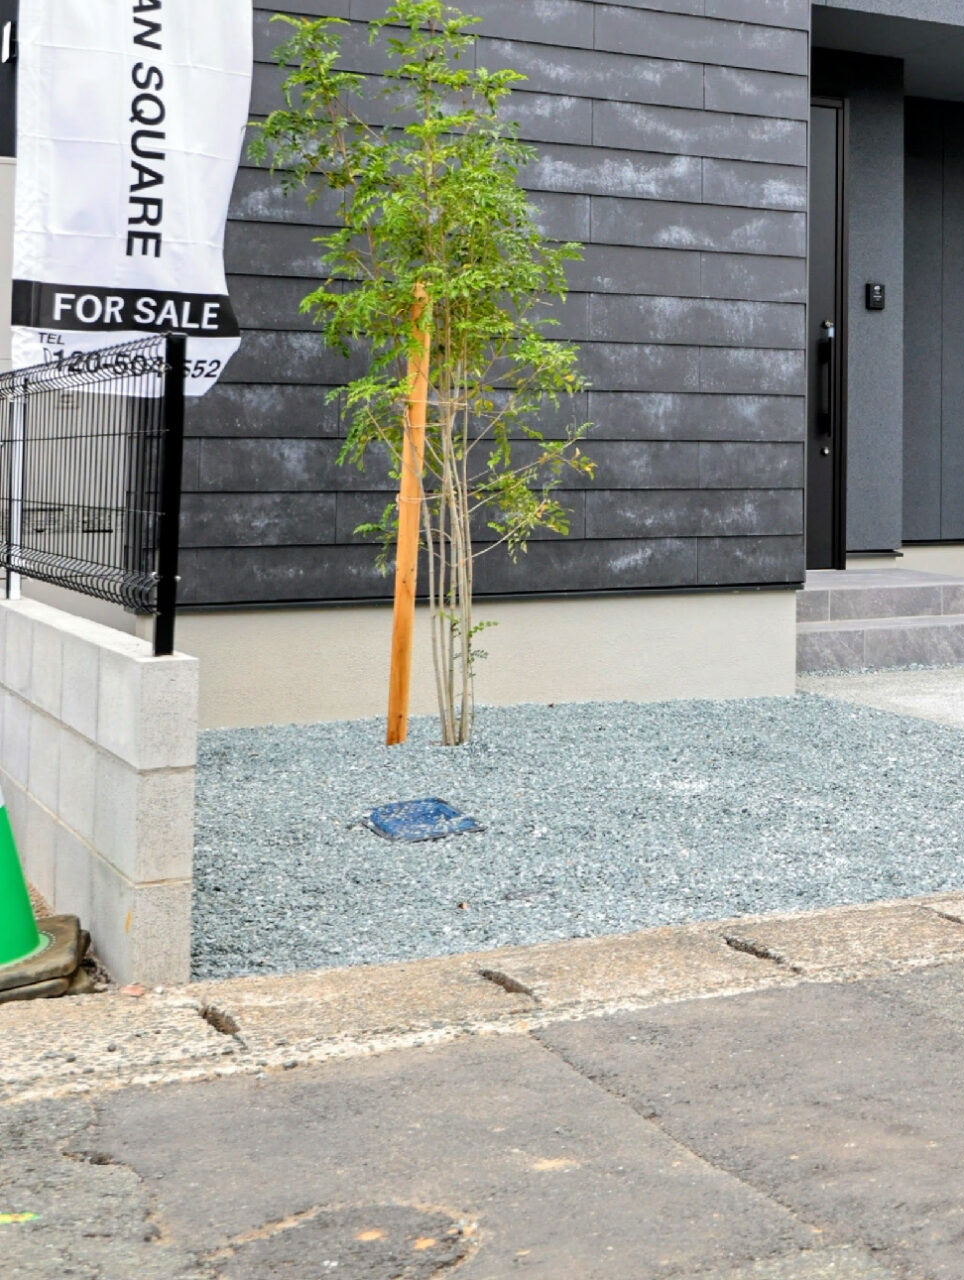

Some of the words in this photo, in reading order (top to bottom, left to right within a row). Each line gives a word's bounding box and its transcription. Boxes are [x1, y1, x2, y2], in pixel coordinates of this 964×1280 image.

[126, 62, 166, 258] SQUARE
[53, 292, 124, 324] FOR
[134, 297, 220, 330] SALE
[38, 331, 65, 345] TEL
